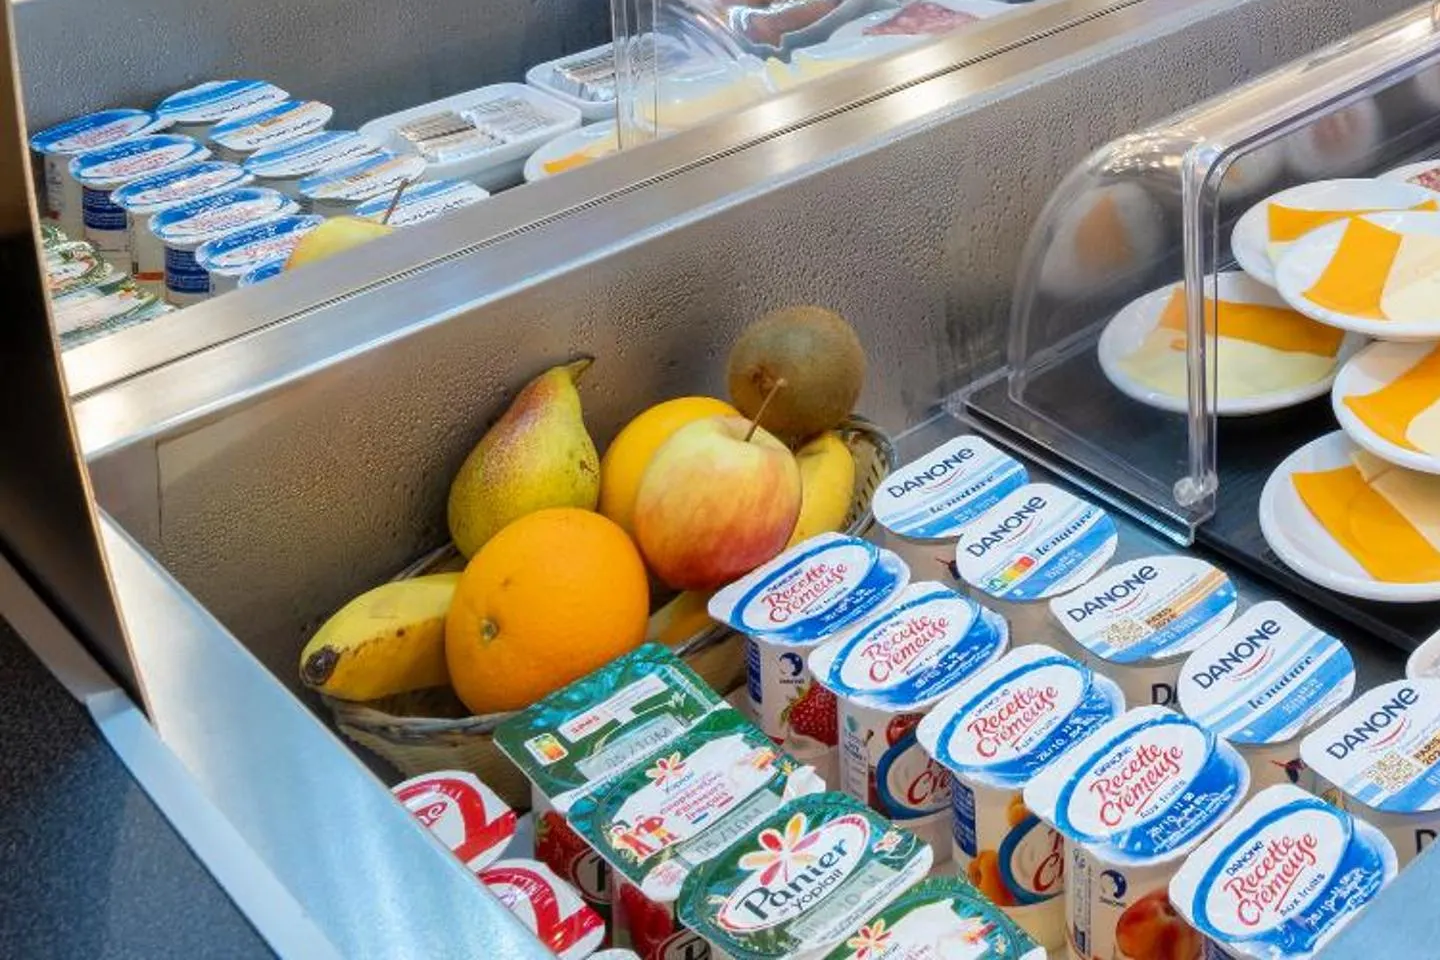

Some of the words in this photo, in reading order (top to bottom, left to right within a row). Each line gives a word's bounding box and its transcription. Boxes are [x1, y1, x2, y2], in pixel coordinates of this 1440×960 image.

[967, 684, 1039, 738] Recette
[1088, 743, 1164, 801] Recette
[734, 839, 848, 920] Panier
[1223, 834, 1296, 900] Recette
